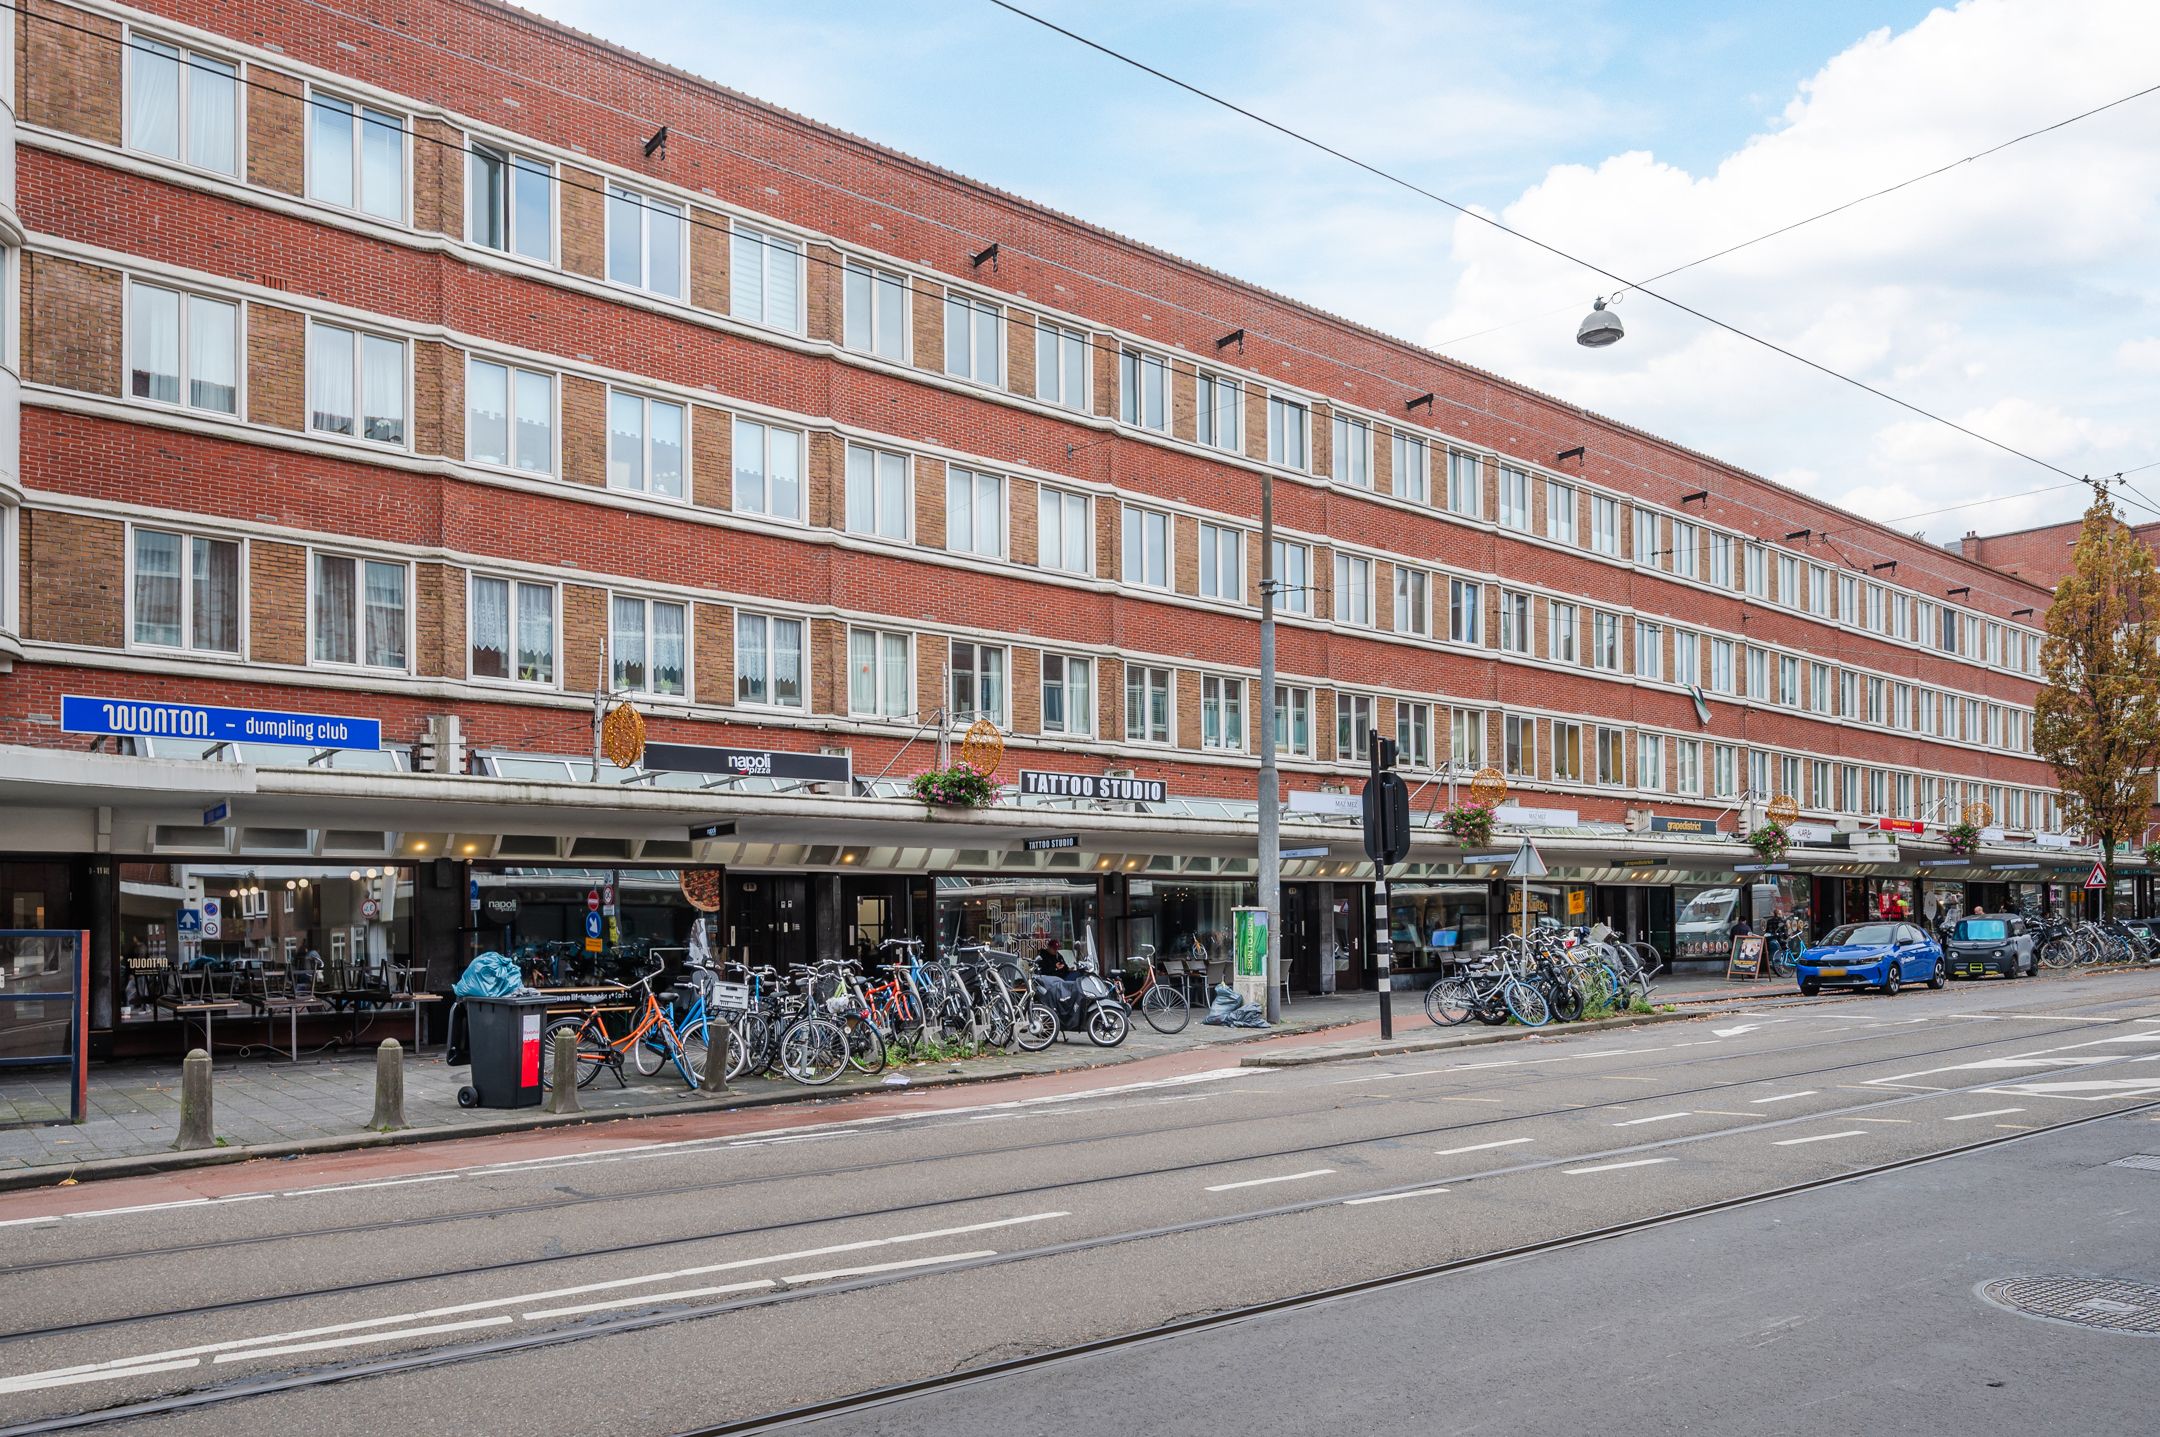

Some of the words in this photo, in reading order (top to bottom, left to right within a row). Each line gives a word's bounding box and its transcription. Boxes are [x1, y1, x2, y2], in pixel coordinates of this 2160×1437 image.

[245, 716, 315, 741] dumpling
[317, 721, 349, 741] club
[728, 753, 772, 771] napoli
[748, 766, 771, 775] pizza
[1027, 773, 1094, 797] TATTOO
[1099, 778, 1162, 801] STUDIO
[1667, 821, 1701, 832] grapedistrict
[1028, 839, 1050, 850] TATTOO
[1051, 837, 1074, 848] STUDIO
[488, 899, 517, 911] napoli
[1247, 938, 1254, 950] TO
